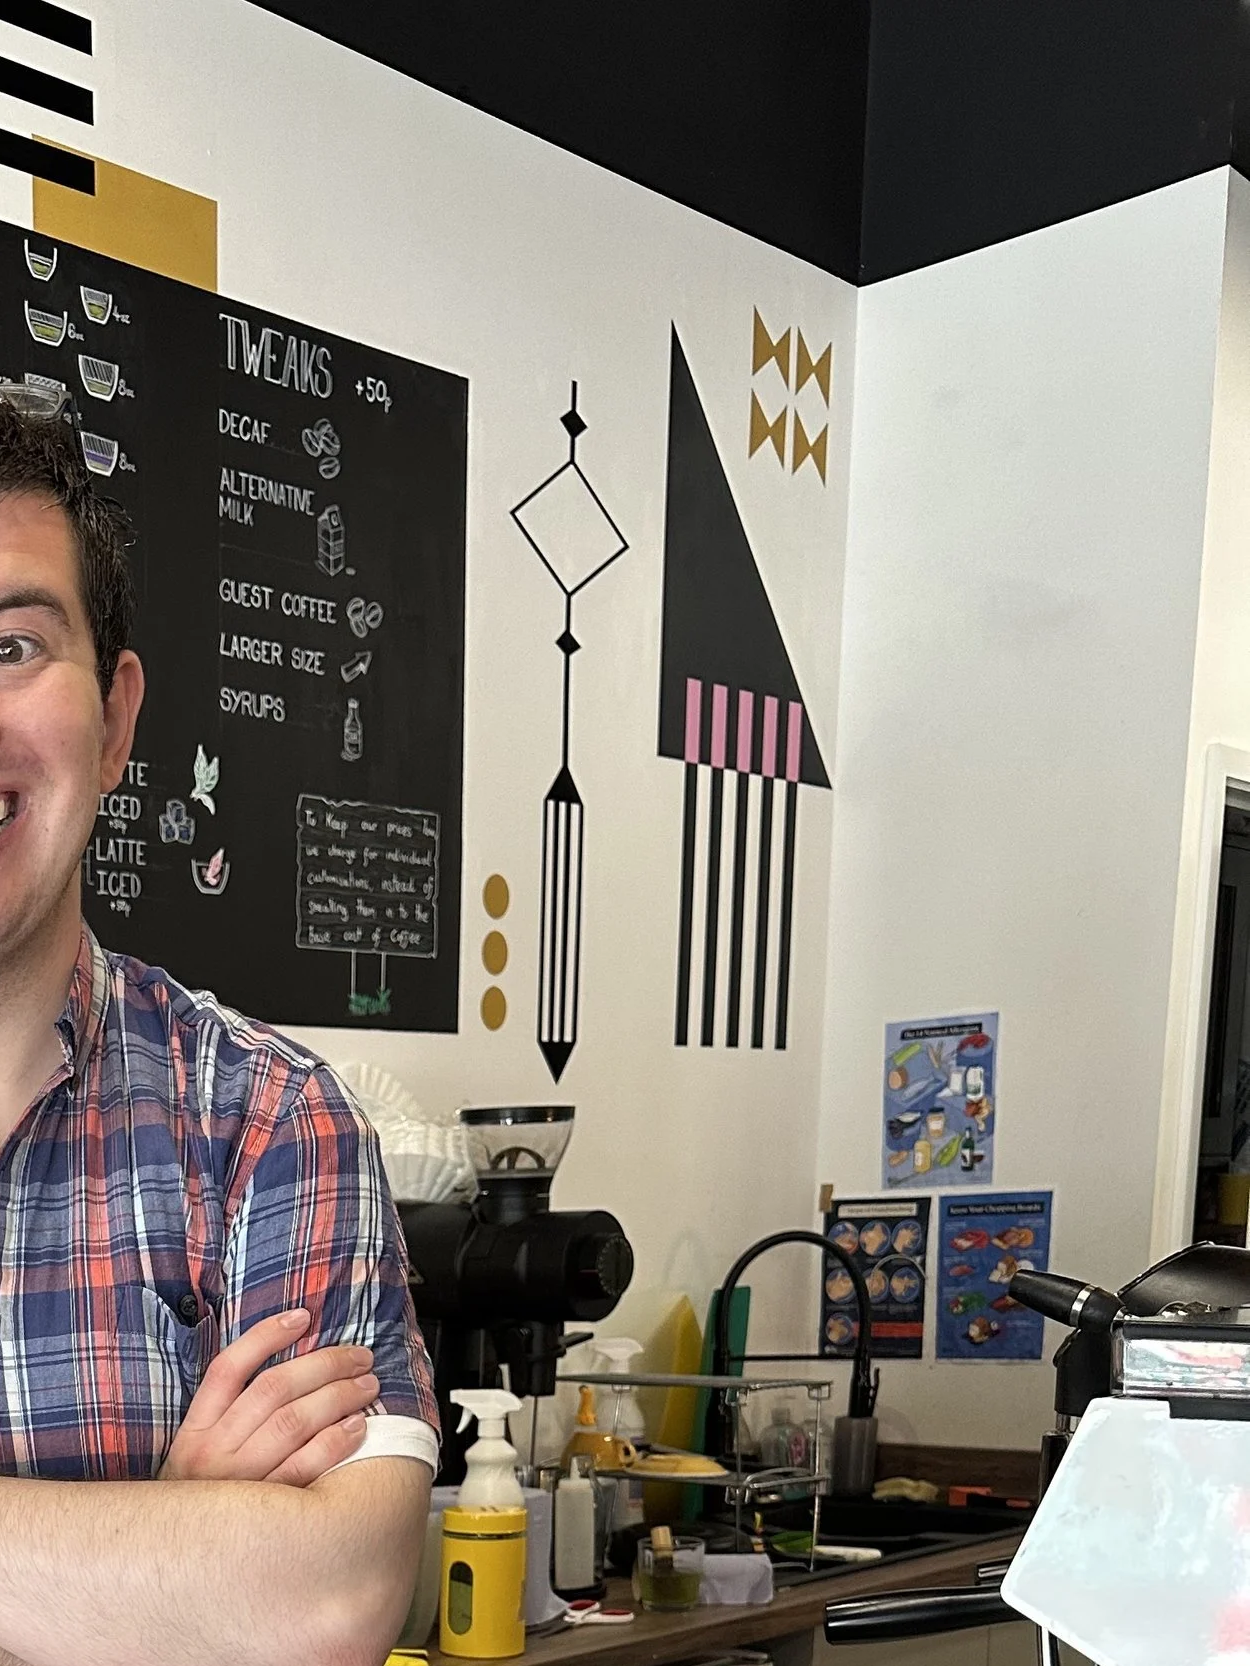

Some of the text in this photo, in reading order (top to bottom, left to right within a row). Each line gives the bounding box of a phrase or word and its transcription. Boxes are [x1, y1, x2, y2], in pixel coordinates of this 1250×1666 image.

[219, 313, 392, 413] TWEAKS +50p
[218, 408, 270, 446] DECAF
[219, 466, 315, 517] ALTERNATIVE
[219, 495, 254, 527] MILK
[219, 577, 337, 625] GUEST COFFEE
[219, 632, 325, 676] LARGER SIZE
[219, 686, 286, 724] SYRUPS
[97, 793, 141, 821] ICED
[95, 837, 147, 866] LATTE
[96, 870, 142, 898] ICED
